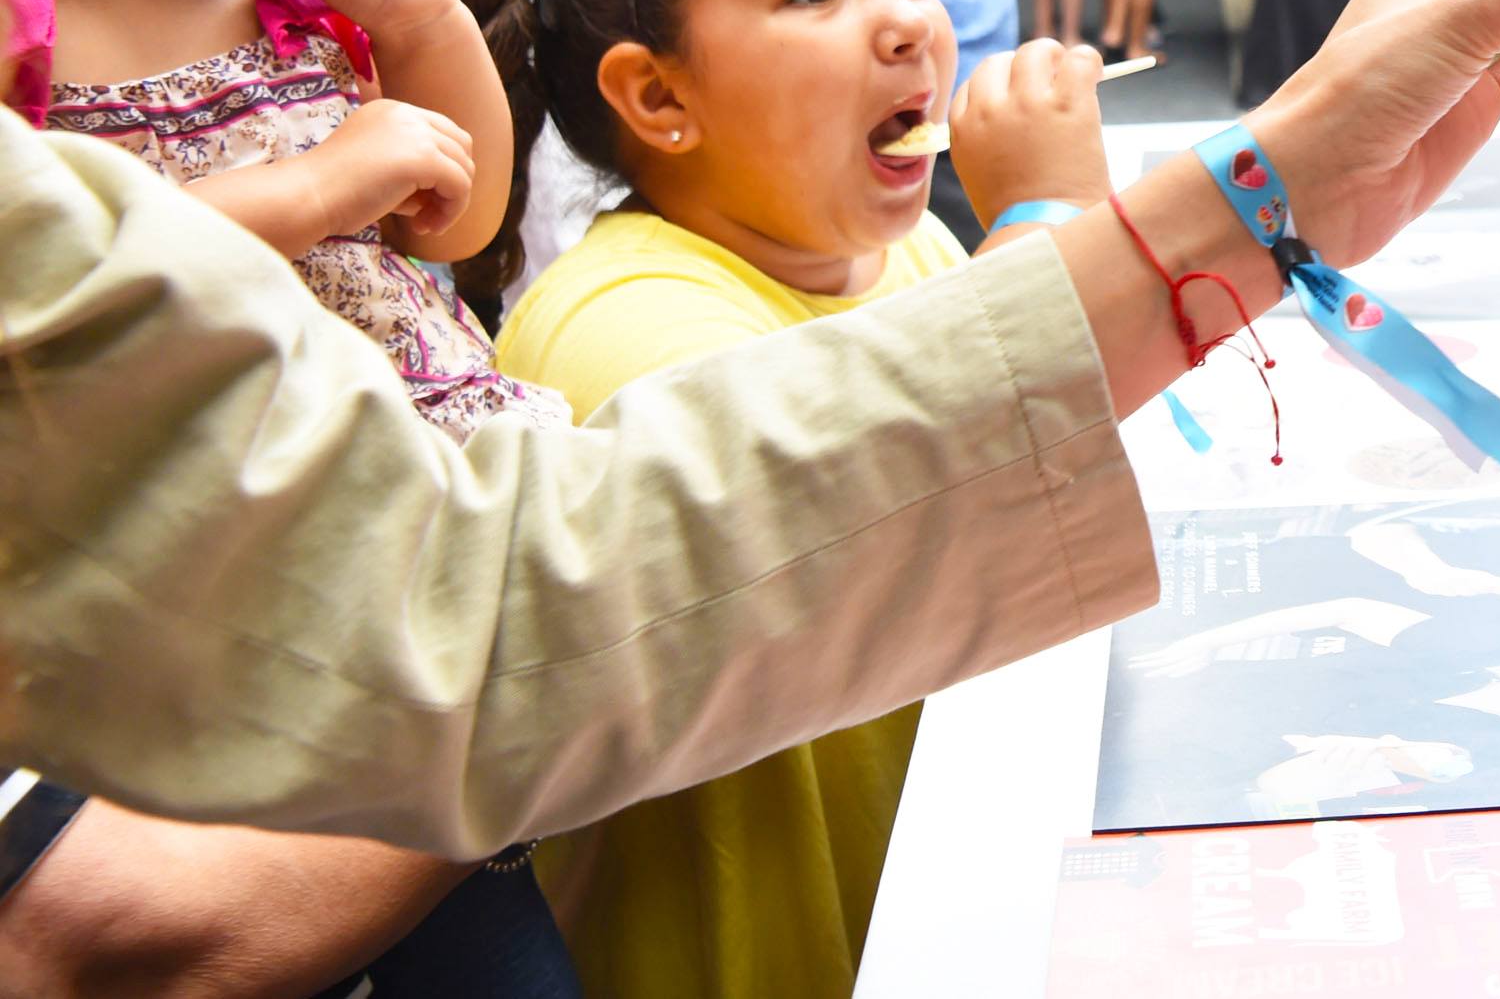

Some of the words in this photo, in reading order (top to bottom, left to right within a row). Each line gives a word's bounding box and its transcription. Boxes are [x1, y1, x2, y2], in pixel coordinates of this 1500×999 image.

[1332, 831, 1365, 884] FAMILY
[1191, 836, 1255, 948] CREAM
[1338, 888, 1371, 935] FARM
